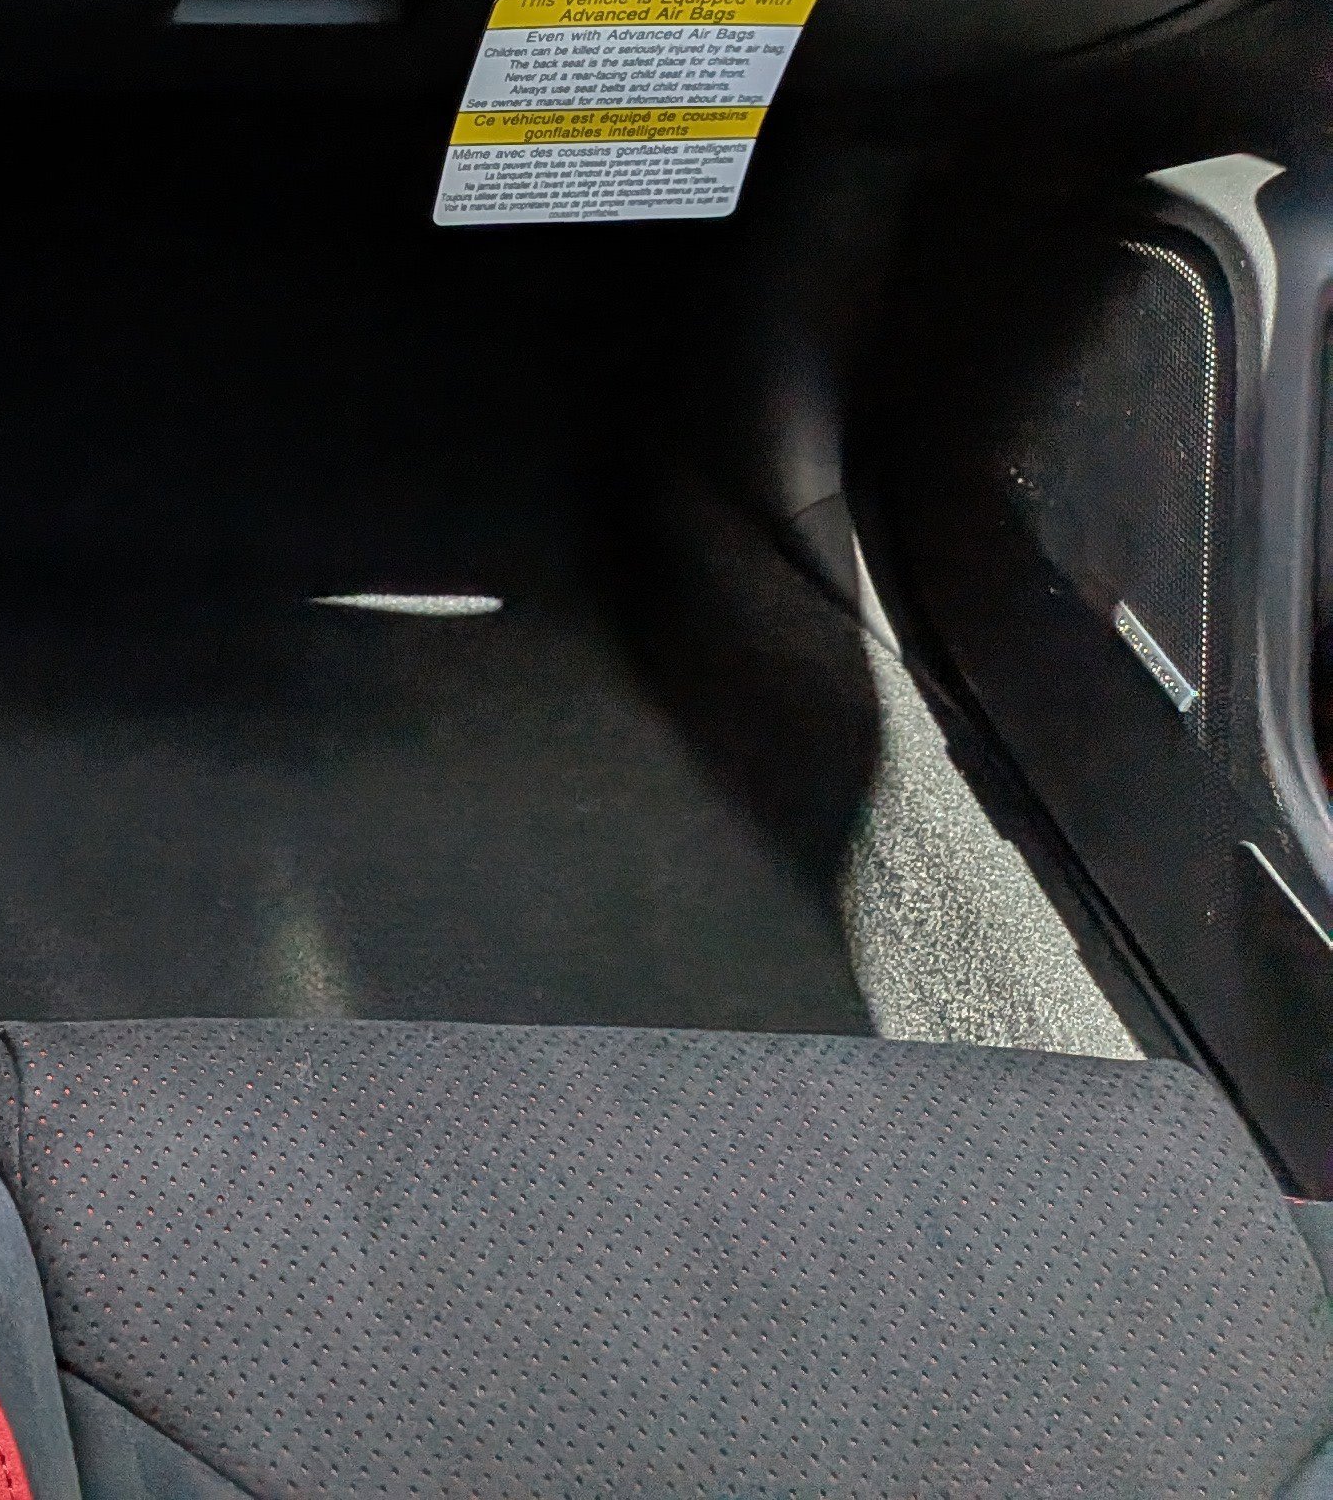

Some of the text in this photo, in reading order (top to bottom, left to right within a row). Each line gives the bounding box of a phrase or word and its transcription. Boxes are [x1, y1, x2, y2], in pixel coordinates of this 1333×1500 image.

[559, 7, 735, 23] Advanced Air Bags
[526, 29, 755, 43] Even with Advanced Air Bags
[484, 48, 527, 58] Children
[531, 48, 551, 56] can
[555, 46, 568, 55] be
[572, 45, 599, 55] killed
[603, 46, 615, 55] or
[707, 44, 720, 55] by
[725, 44, 741, 53] the
[746, 45, 760, 53] air
[510, 60, 529, 69] The
[533, 60, 558, 68] back
[562, 59, 585, 67] seat
[588, 59, 597, 67] is
[602, 58, 618, 67] the
[656, 58, 686, 67] place
[690, 57, 703, 66] for
[505, 73, 536, 82] Never
[539, 72, 557, 83] put
[631, 70, 656, 79] child
[686, 70, 695, 78] in
[699, 69, 715, 78] the
[510, 85, 547, 96] Always
[628, 83, 650, 92] and
[653, 82, 679, 91] child
[467, 99, 487, 108] See
[475, 110, 748, 126] Ce véhicule est équipé de coussins
[524, 126, 689, 143] gonflables intelligents
[452, 144, 747, 159] Même avec des coussins gonflables intelligents
